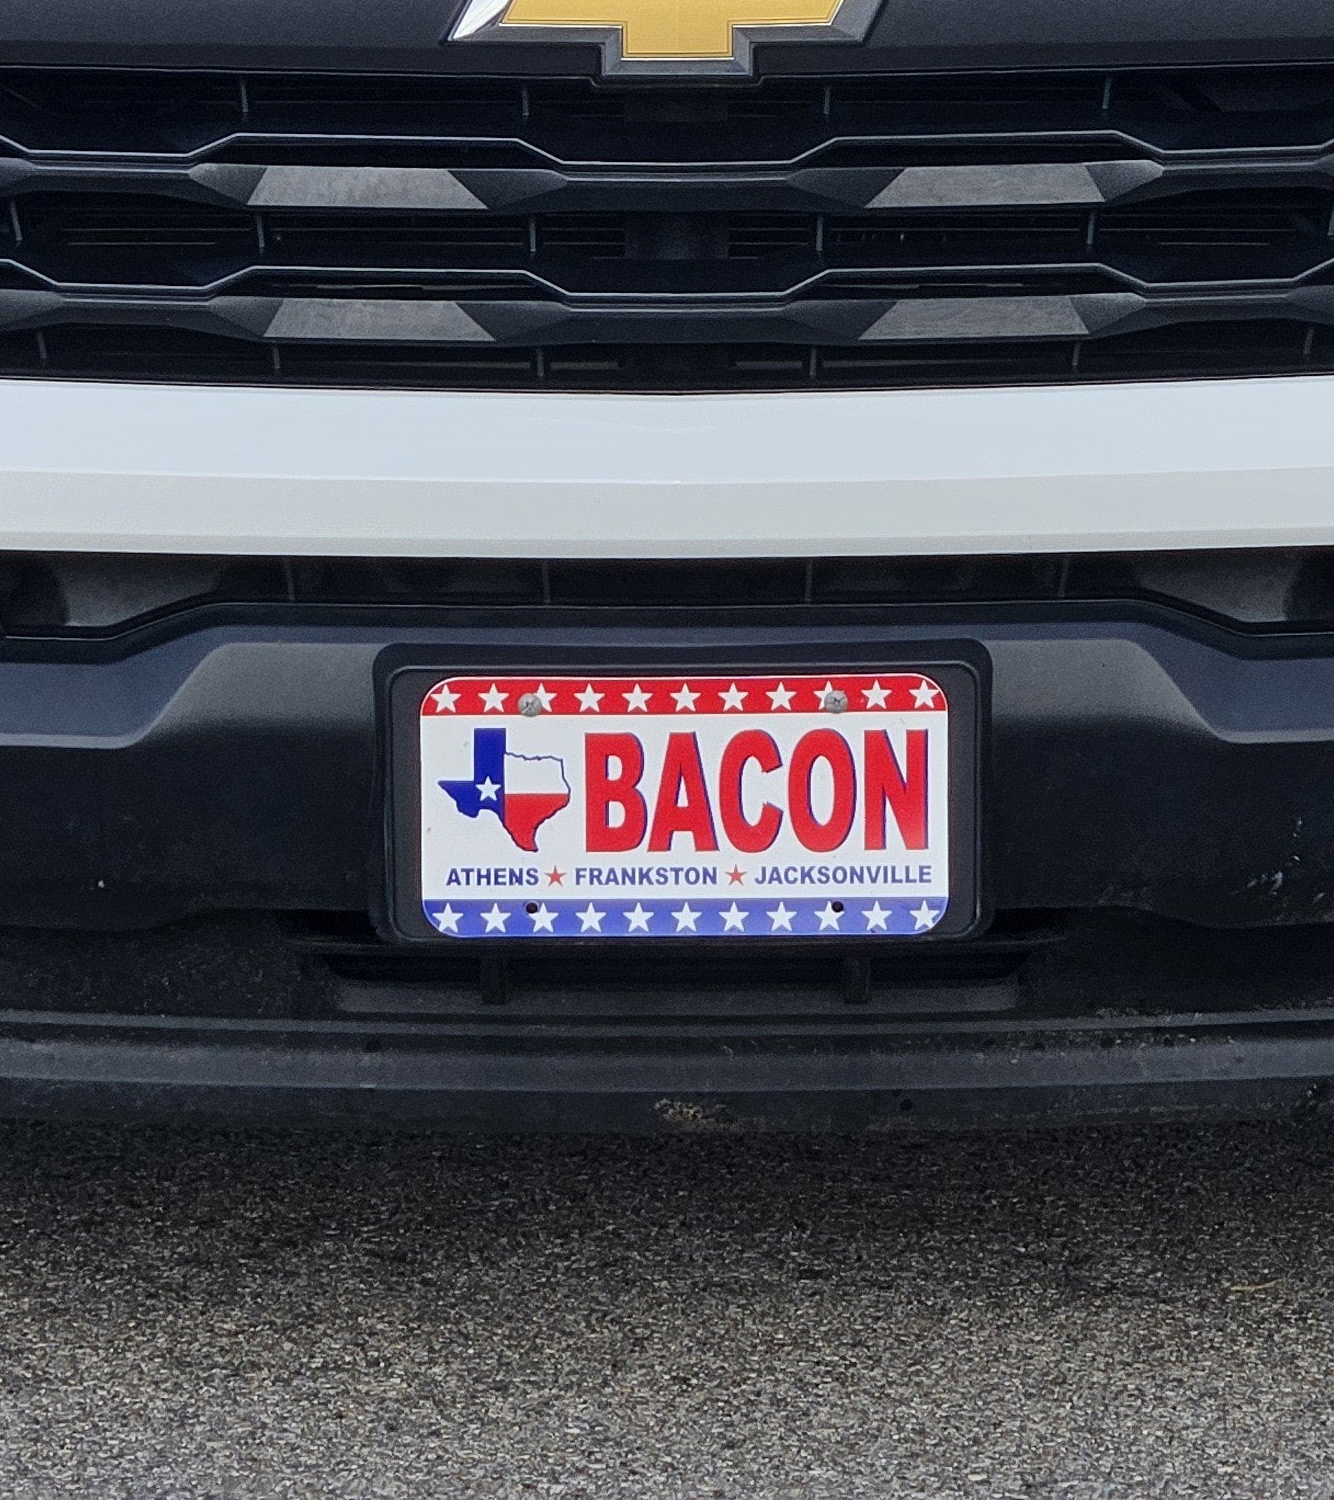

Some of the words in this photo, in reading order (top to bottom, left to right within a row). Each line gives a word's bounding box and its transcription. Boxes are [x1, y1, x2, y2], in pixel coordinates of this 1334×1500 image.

[584, 728, 929, 853] BACON
[446, 867, 539, 886] ATHENS
[575, 866, 718, 885] FRANKSTON
[754, 865, 932, 885] JACKSONVILLE
